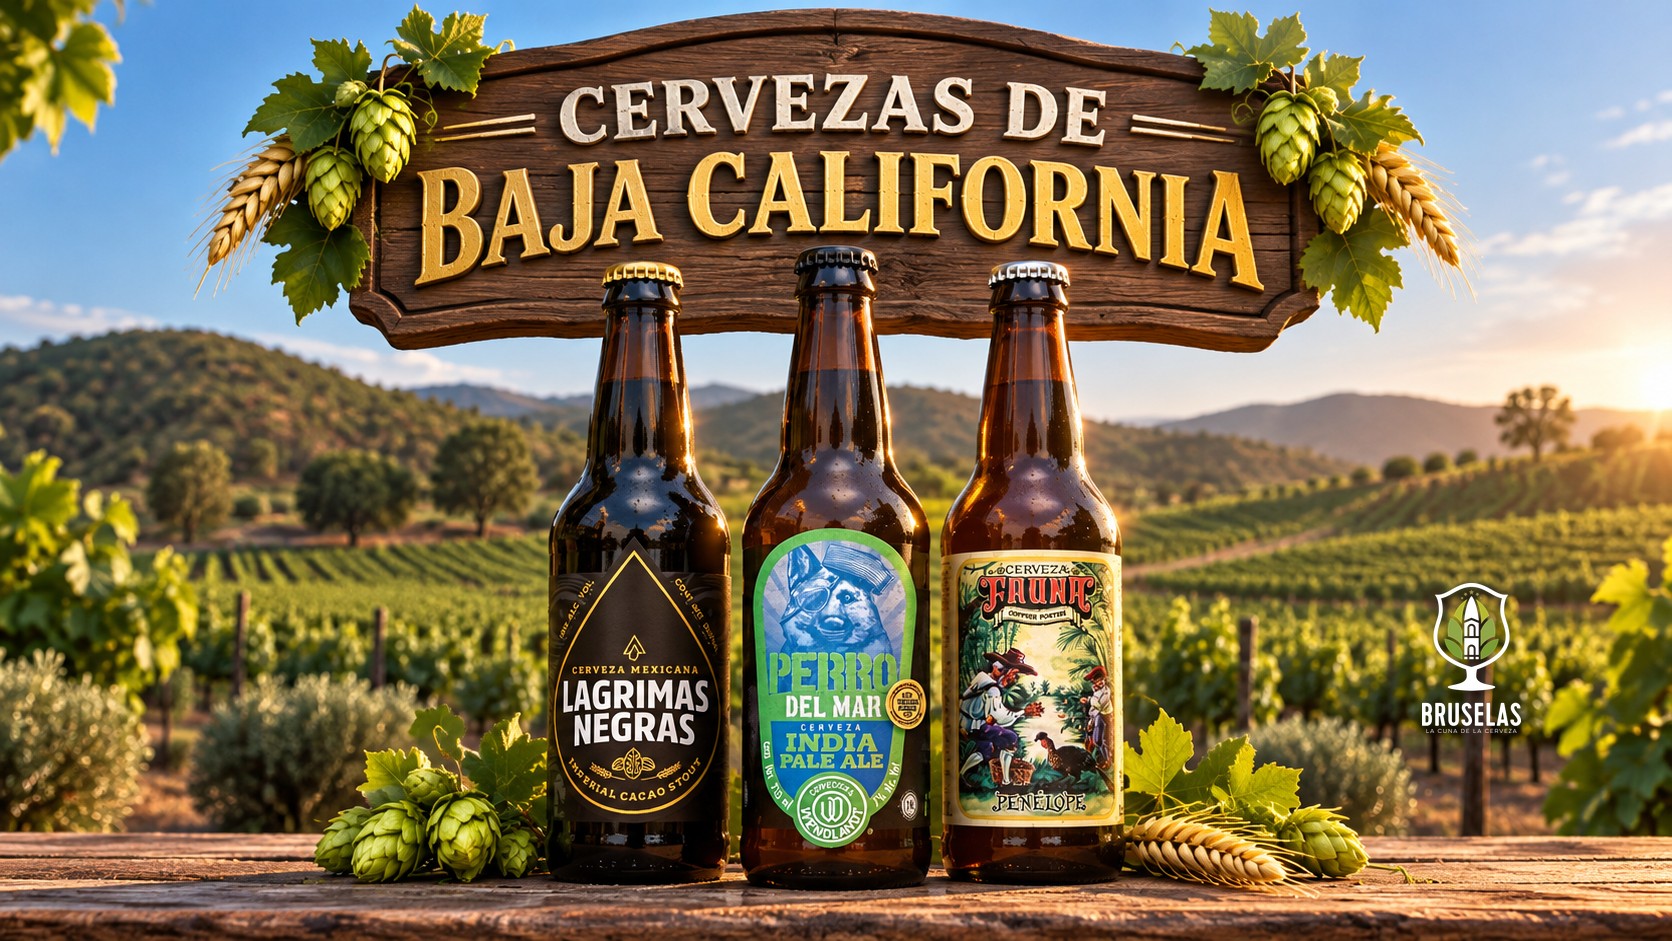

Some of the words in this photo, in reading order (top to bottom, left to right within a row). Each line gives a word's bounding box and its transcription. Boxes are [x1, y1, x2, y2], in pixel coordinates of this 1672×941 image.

[558, 73, 974, 147] CERVEZAS
[1003, 80, 1107, 147] DE
[413, 158, 664, 289] BAJA
[686, 149, 1266, 294] CALIFORNIA
[1006, 564, 1068, 574] CERVEZA
[979, 576, 1094, 614] FAUNA
[572, 665, 625, 674] CERVEZA
[630, 665, 699, 674] MEXICANA
[768, 652, 897, 695] PERRO
[563, 679, 709, 714] LAGRIMAS
[786, 695, 826, 718] DEL
[832, 695, 882, 718] MAR
[573, 712, 695, 747] NEGRAS
[786, 733, 878, 752] INDIA
[800, 723, 862, 732] CERVEZA
[780, 753, 835, 769] PALE
[840, 753, 884, 769] ALE
[568, 756, 616, 800] IMPERIAL
[620, 787, 666, 802] CACAO
[668, 756, 702, 793] STOUT
